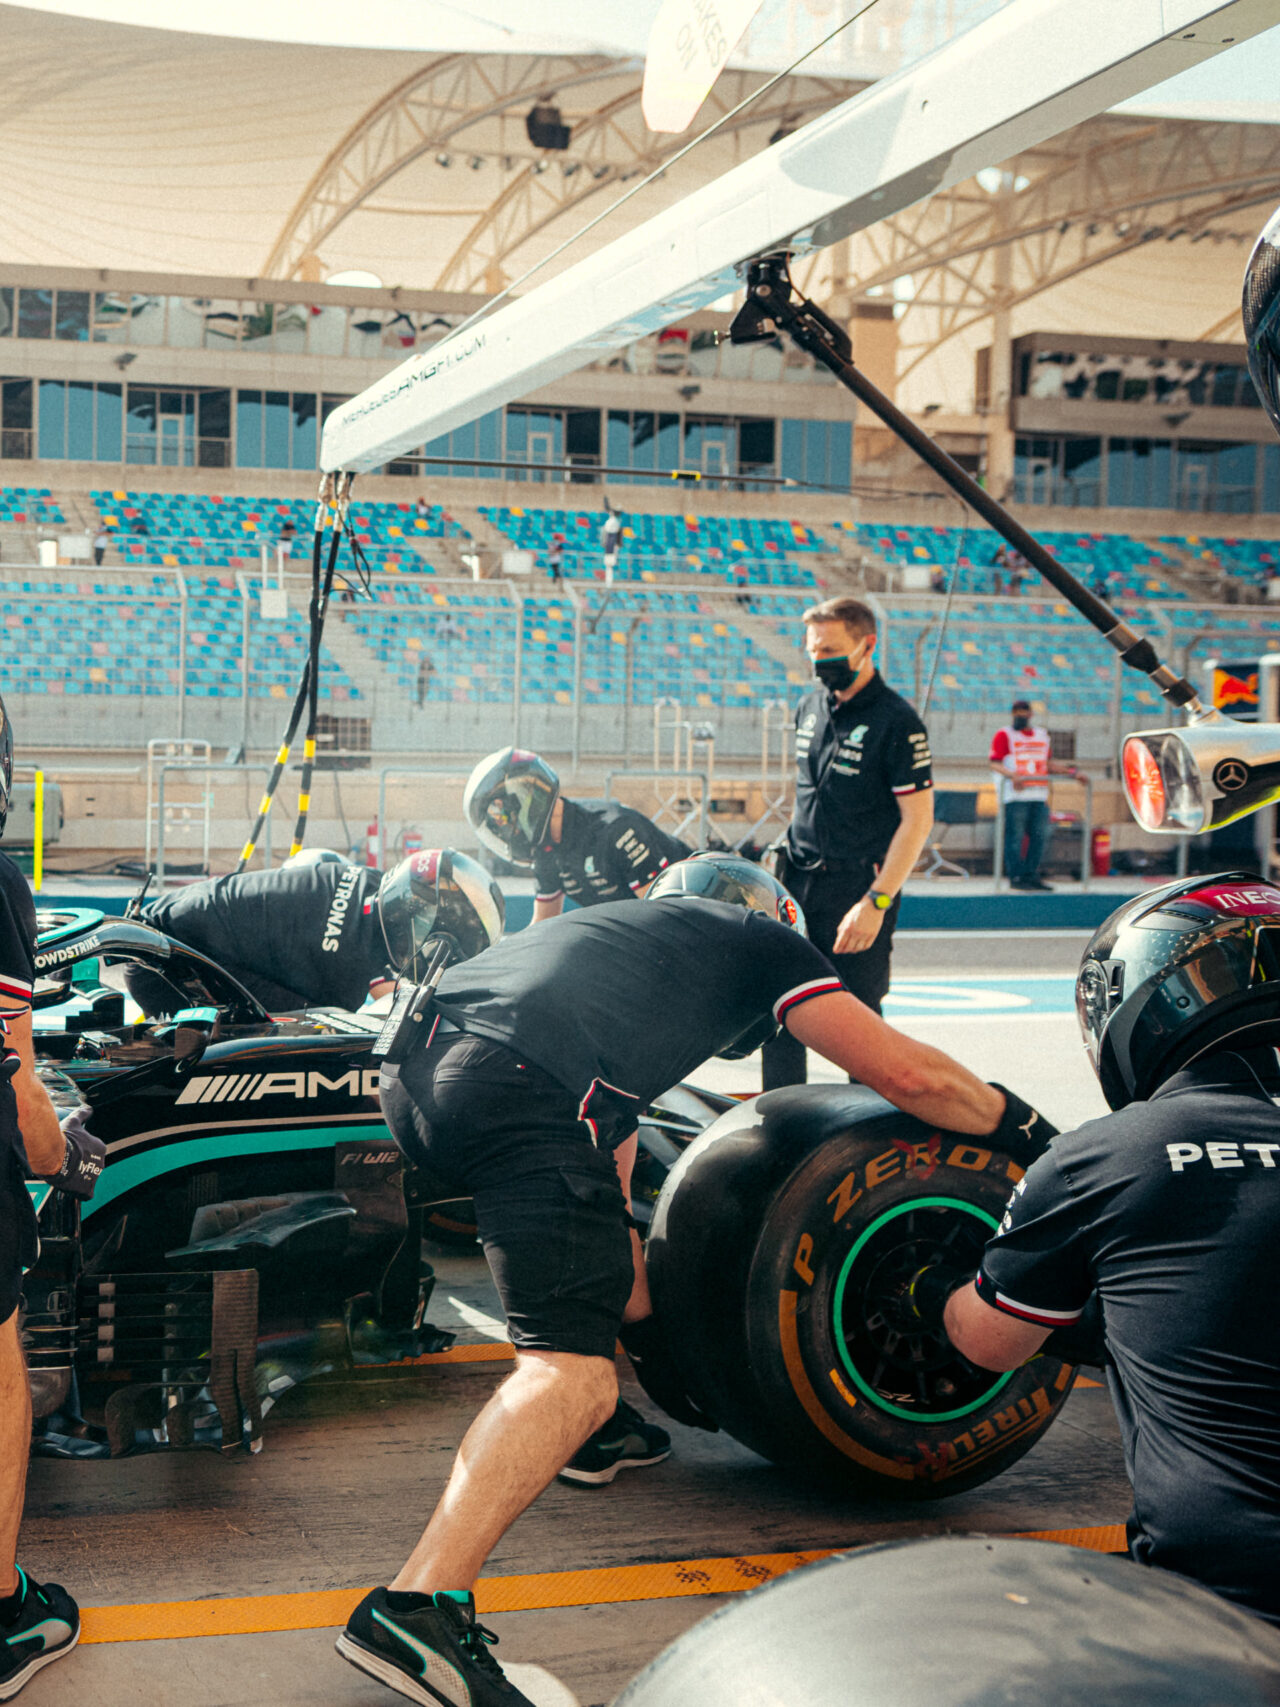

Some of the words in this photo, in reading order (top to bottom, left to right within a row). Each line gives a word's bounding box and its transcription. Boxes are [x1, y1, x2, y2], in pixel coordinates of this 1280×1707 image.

[33, 935, 101, 969] OWDSTRIKE
[322, 864, 363, 953] PETRONAS
[793, 1232, 815, 1286] P
[826, 1142, 994, 1234] ZERO
